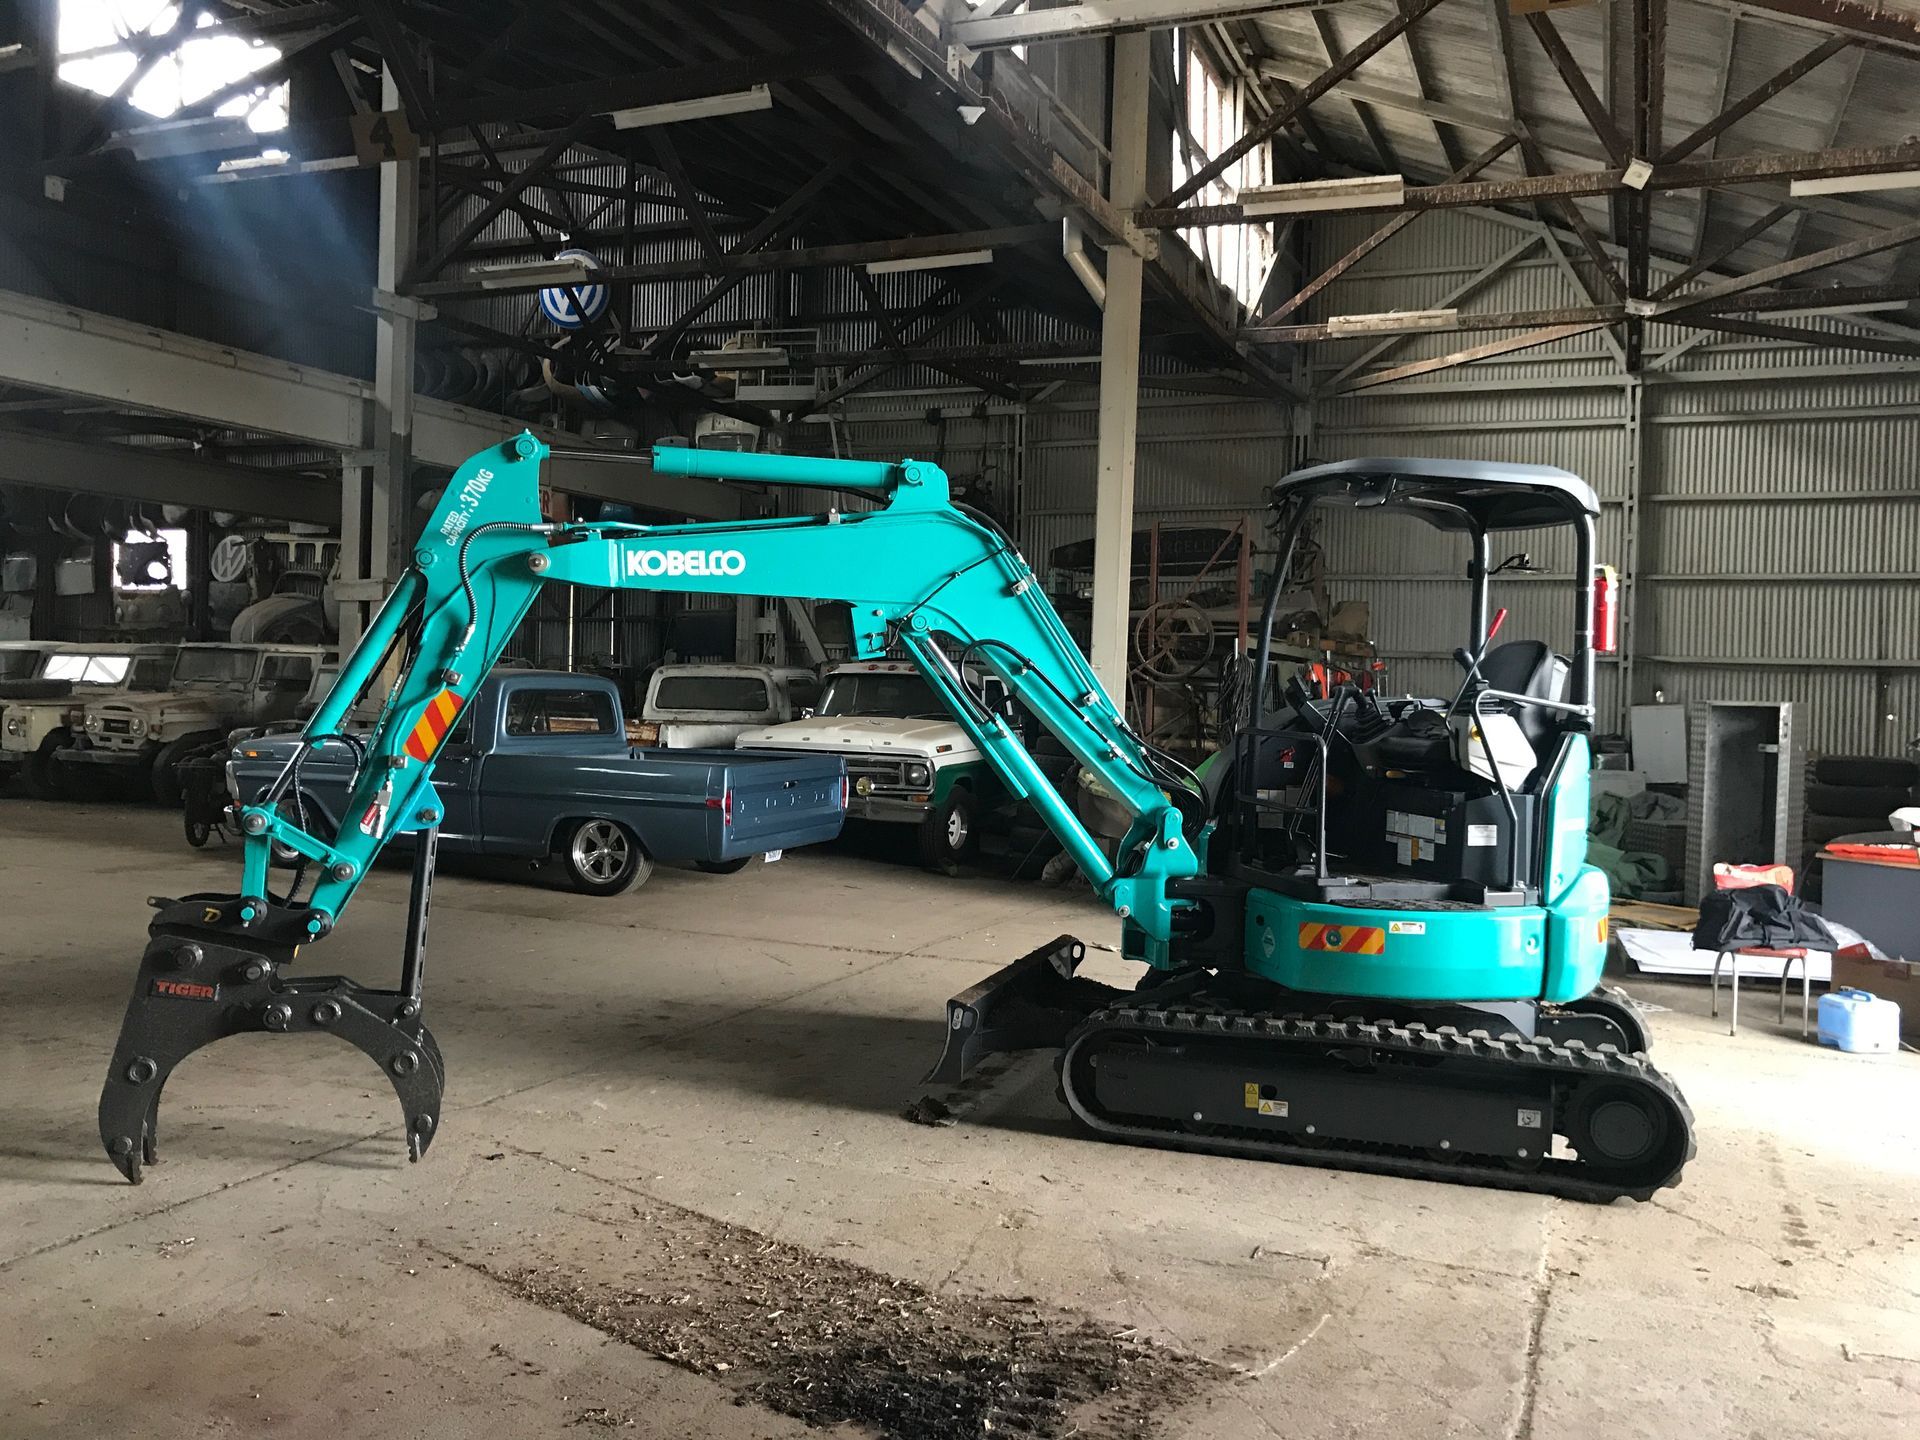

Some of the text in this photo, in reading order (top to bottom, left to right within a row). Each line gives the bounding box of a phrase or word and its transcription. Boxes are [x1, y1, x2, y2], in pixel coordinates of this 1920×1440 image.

[369, 116, 397, 159] 4
[440, 510, 460, 536] RATED
[626, 549, 747, 577] KOBELCO
[156, 979, 215, 999] TIGER
